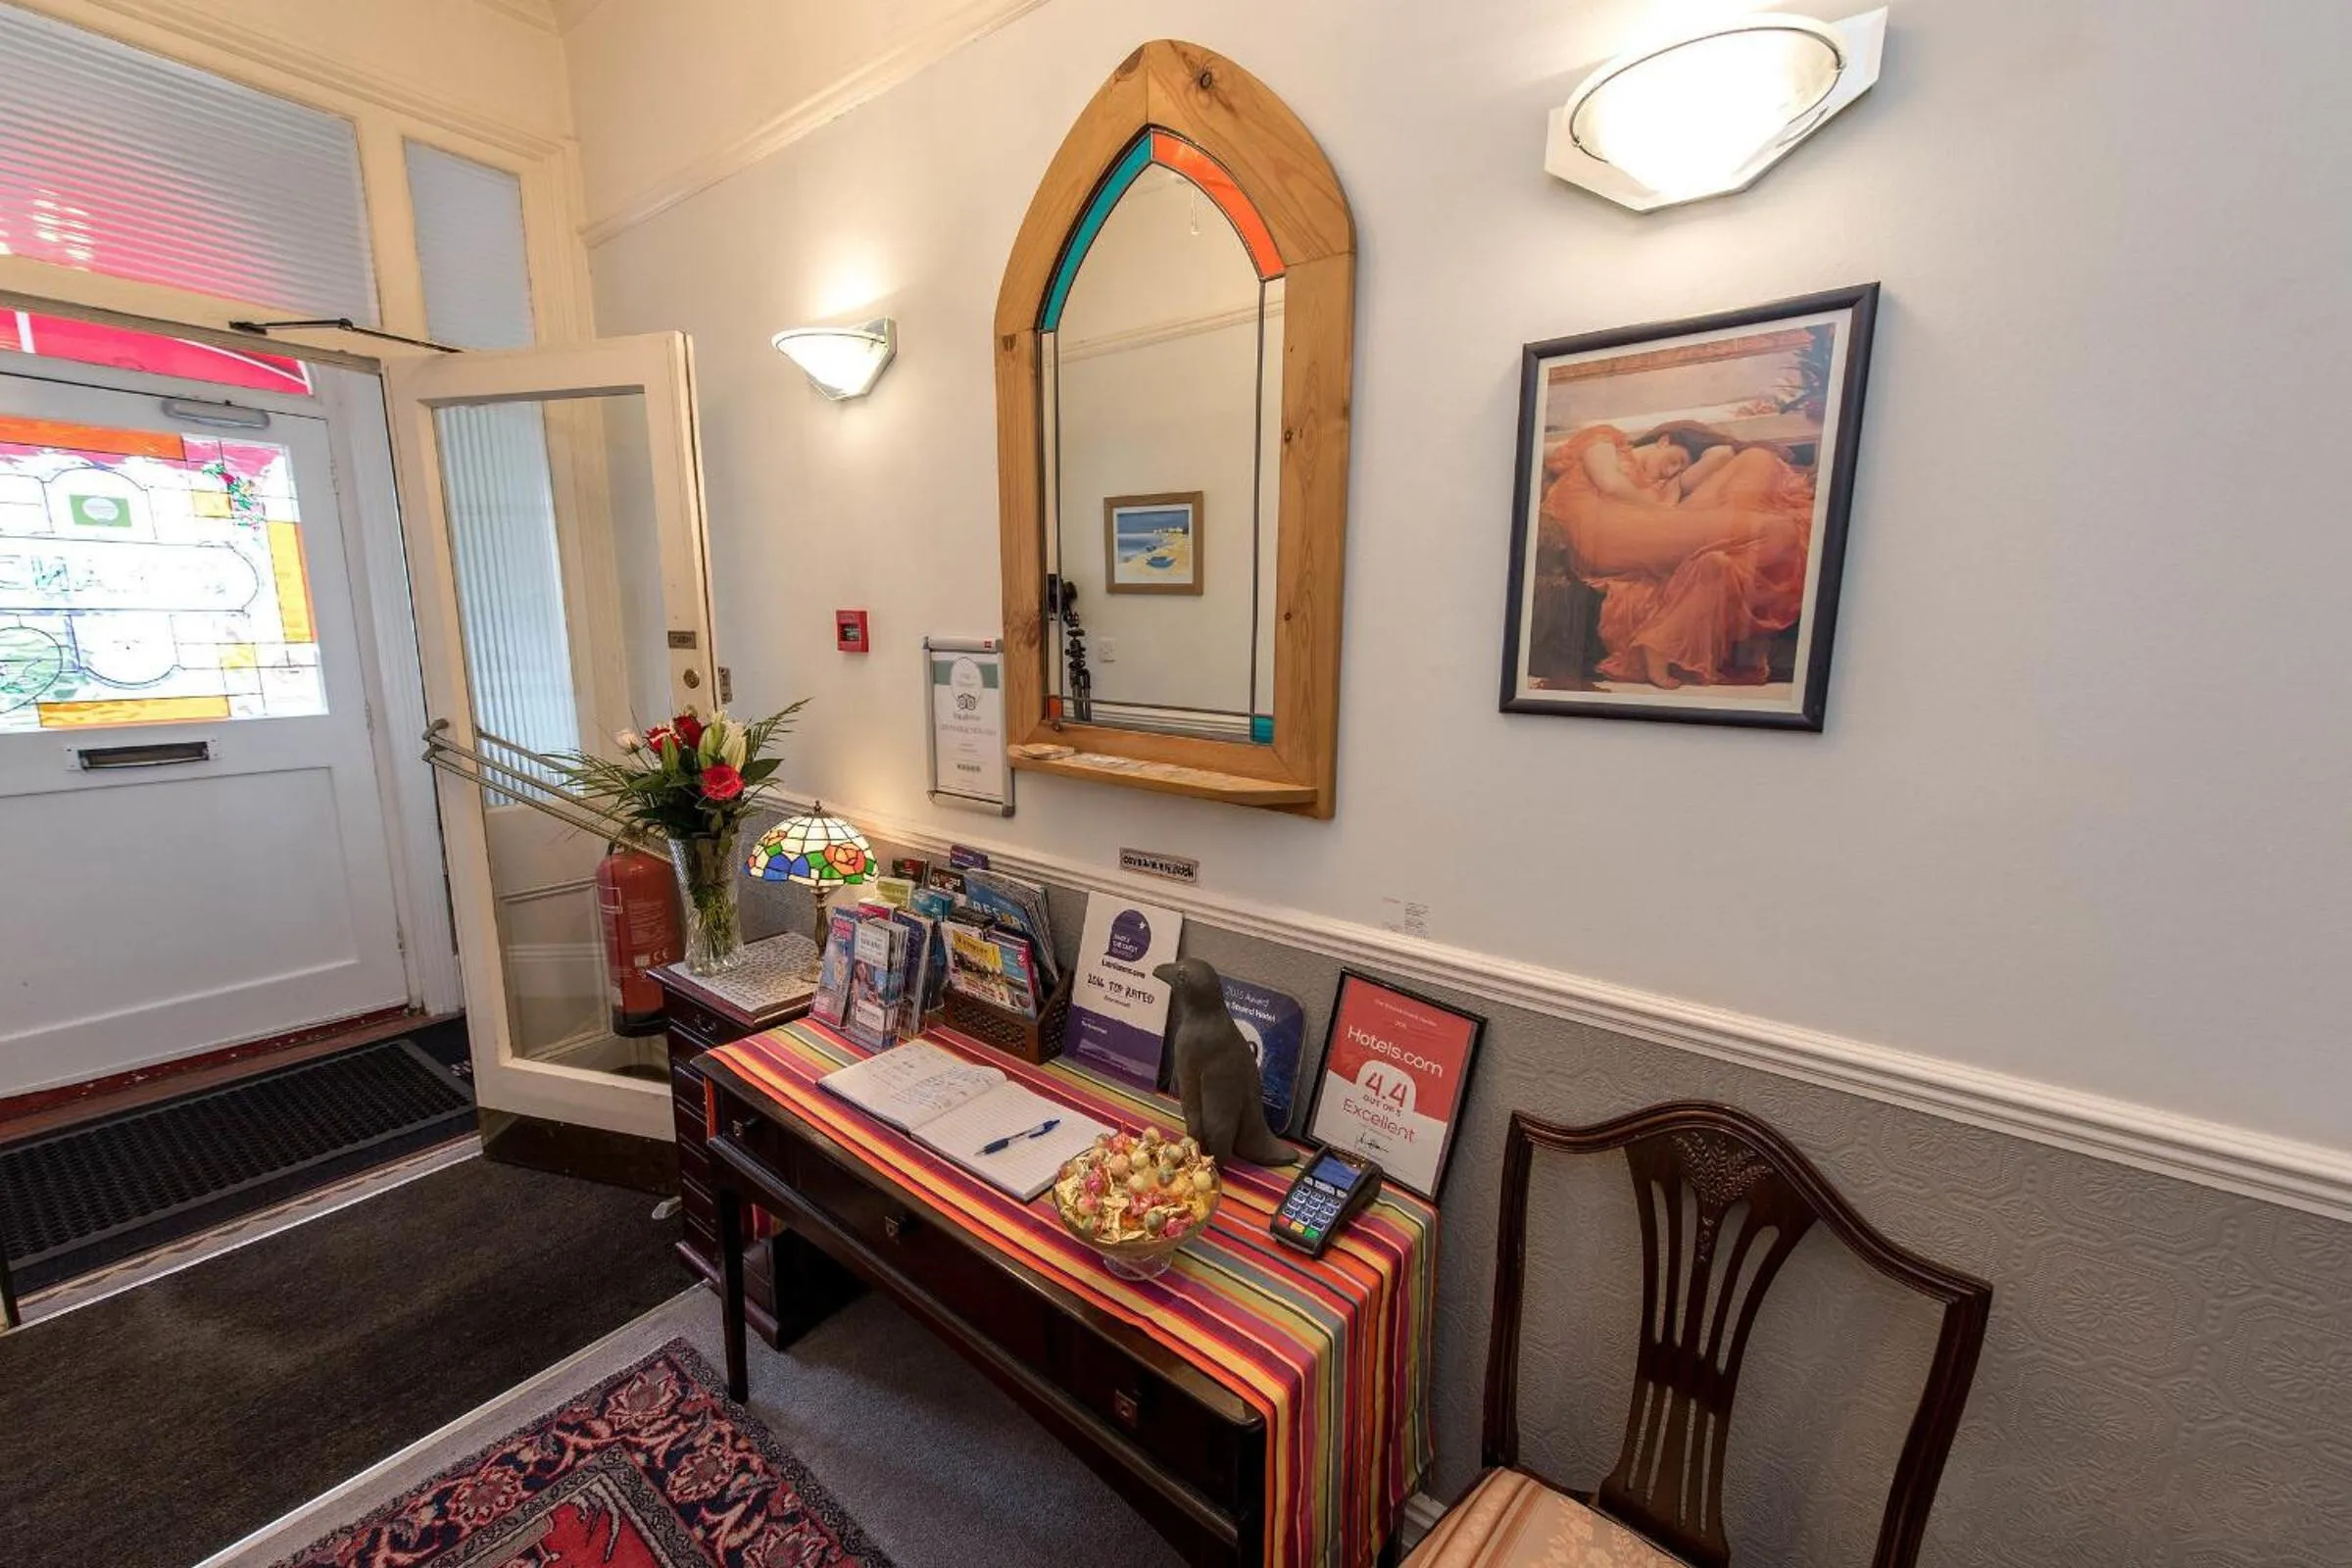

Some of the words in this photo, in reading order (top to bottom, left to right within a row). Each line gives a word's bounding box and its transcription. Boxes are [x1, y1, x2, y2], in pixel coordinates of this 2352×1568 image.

[1108, 981, 1123, 993] TOP
[1125, 987, 1154, 1004] RATED
[1348, 1025, 1444, 1078] Hotels.com
[1363, 1094, 1381, 1107] OUT
[1365, 1072, 1407, 1107] 4.4
[1343, 1098, 1416, 1144] Excellent
